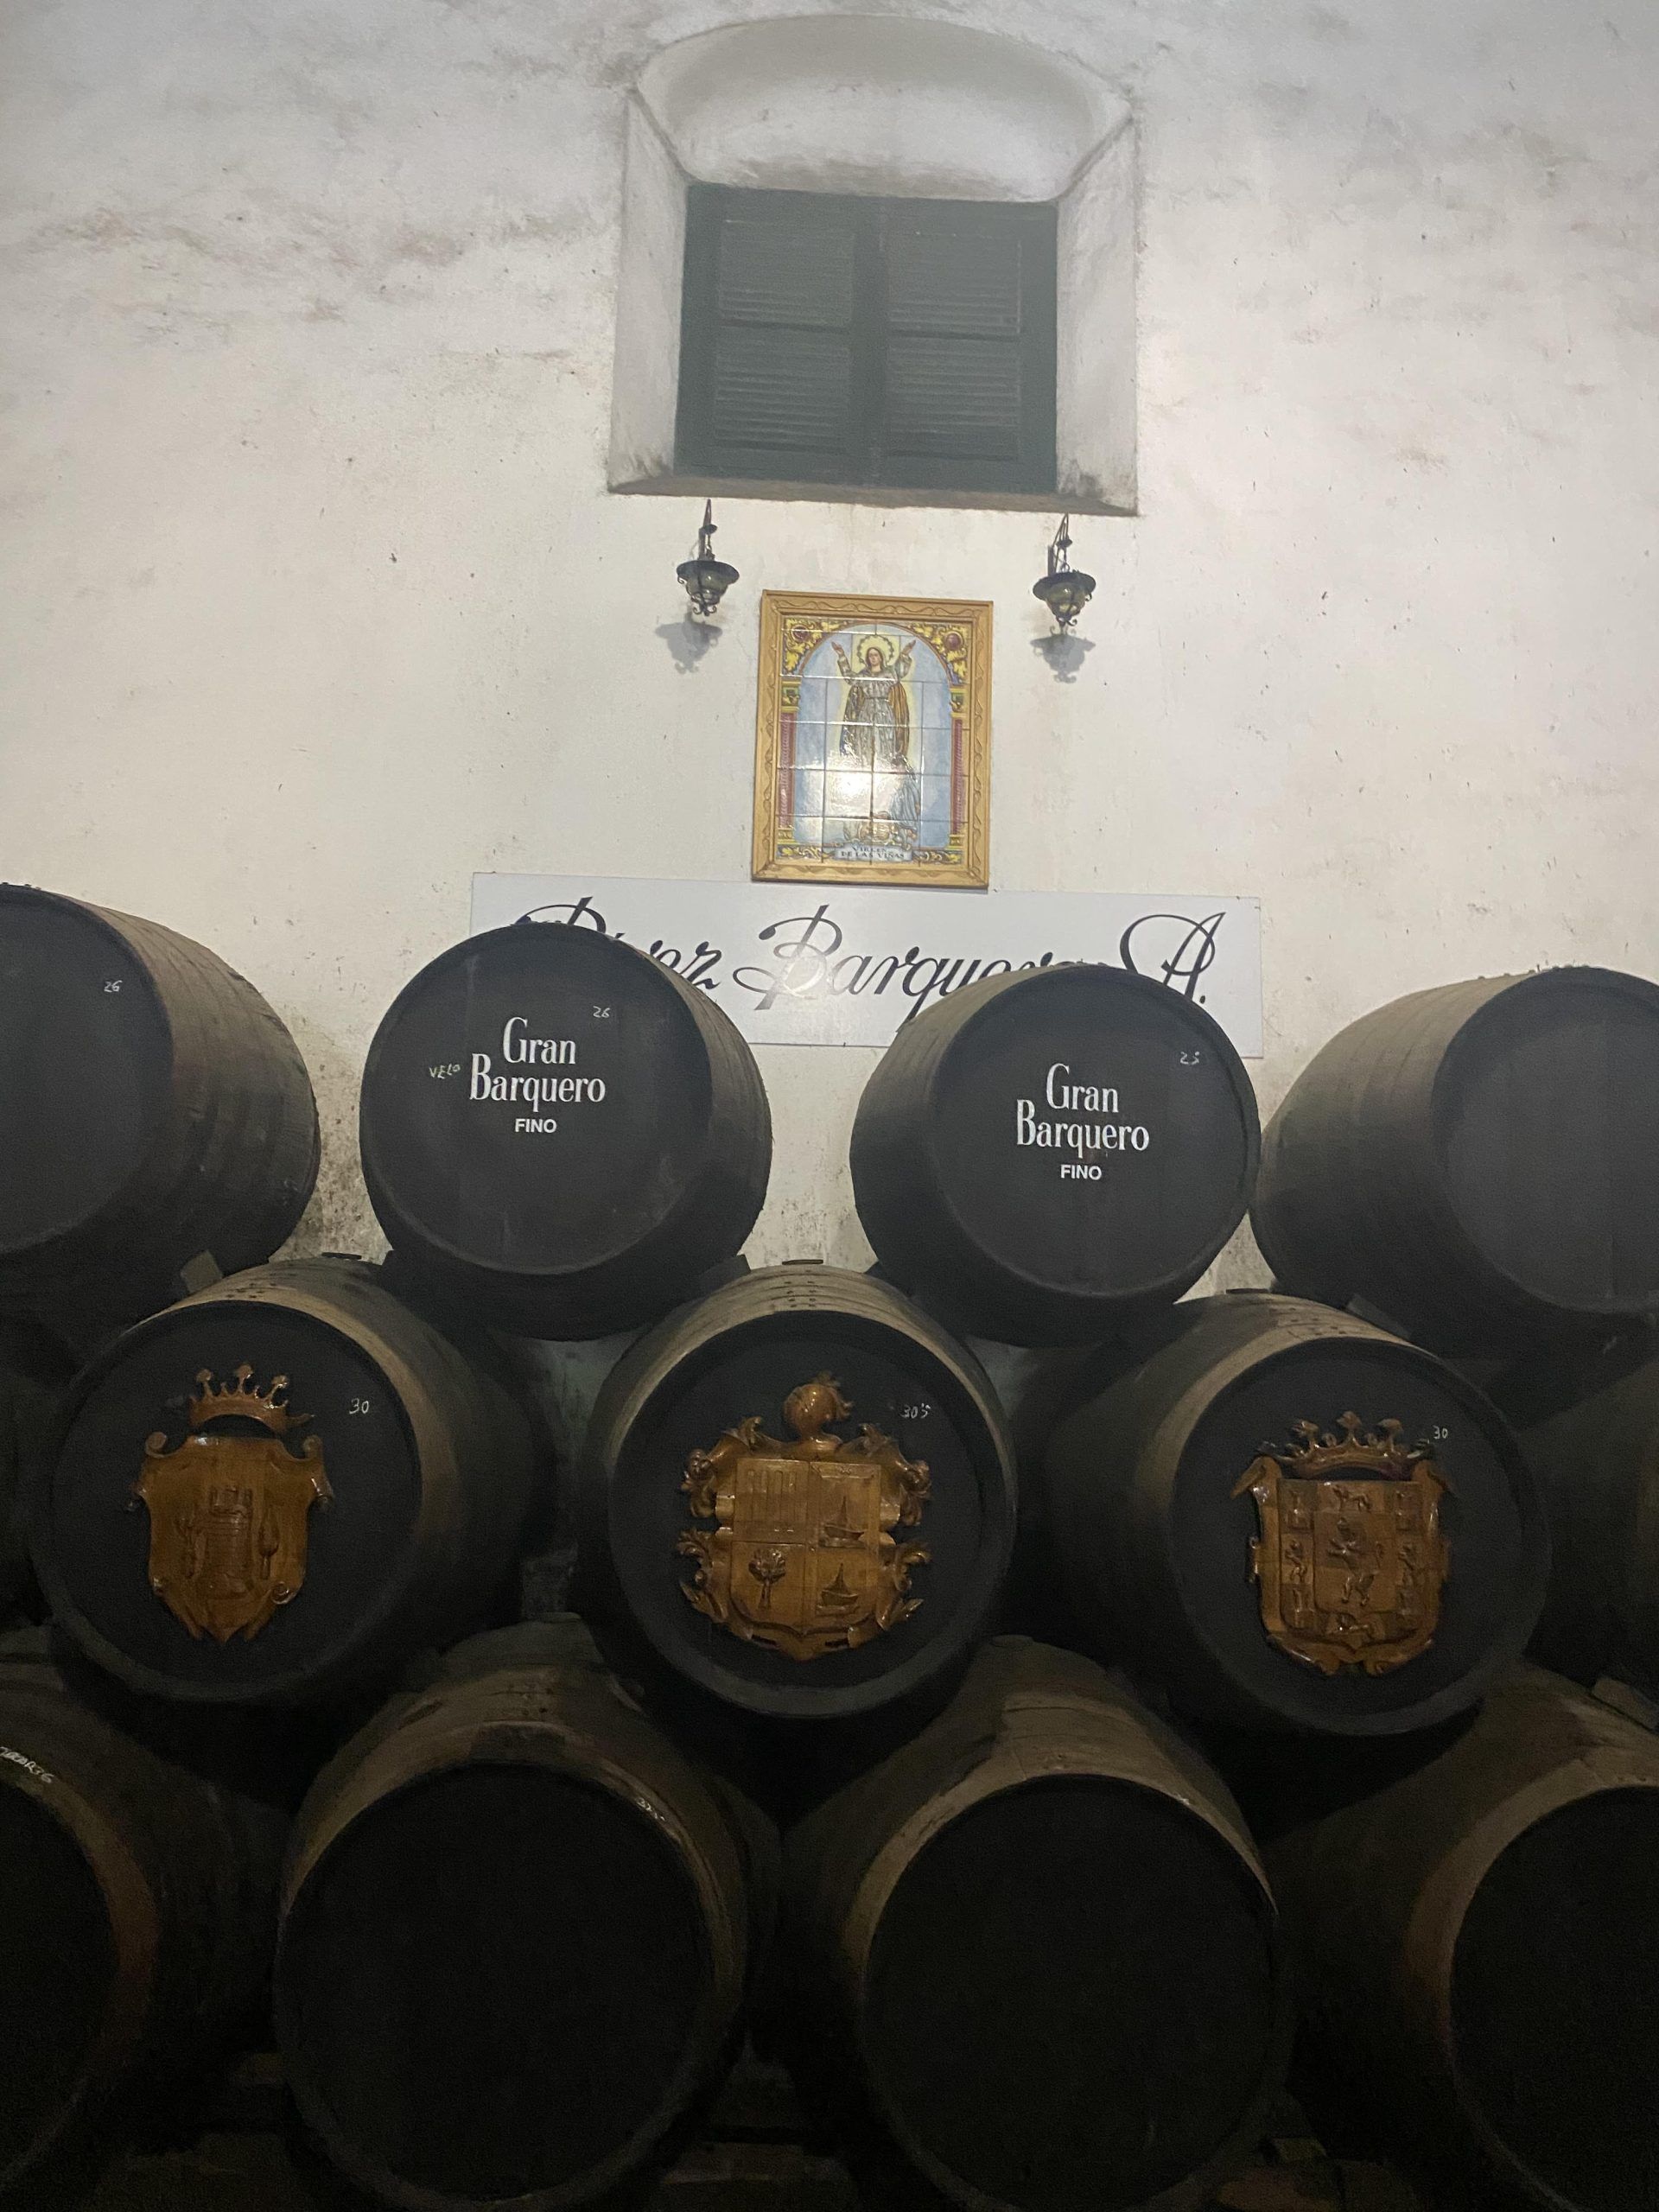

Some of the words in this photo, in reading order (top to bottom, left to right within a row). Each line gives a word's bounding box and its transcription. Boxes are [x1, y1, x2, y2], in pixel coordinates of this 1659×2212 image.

[104, 980, 123, 993] 26
[593, 1005, 610, 1018] 26
[503, 1016, 576, 1065] Gran
[469, 1052, 606, 1113] Barquero
[1046, 1063, 1120, 1113] Gran
[514, 1118, 557, 1134] FINO
[1016, 1098, 1150, 1159] Barquero
[1060, 1164, 1103, 1180] FINO
[349, 1397, 369, 1414] 30
[1433, 1424, 1448, 1440] 30
